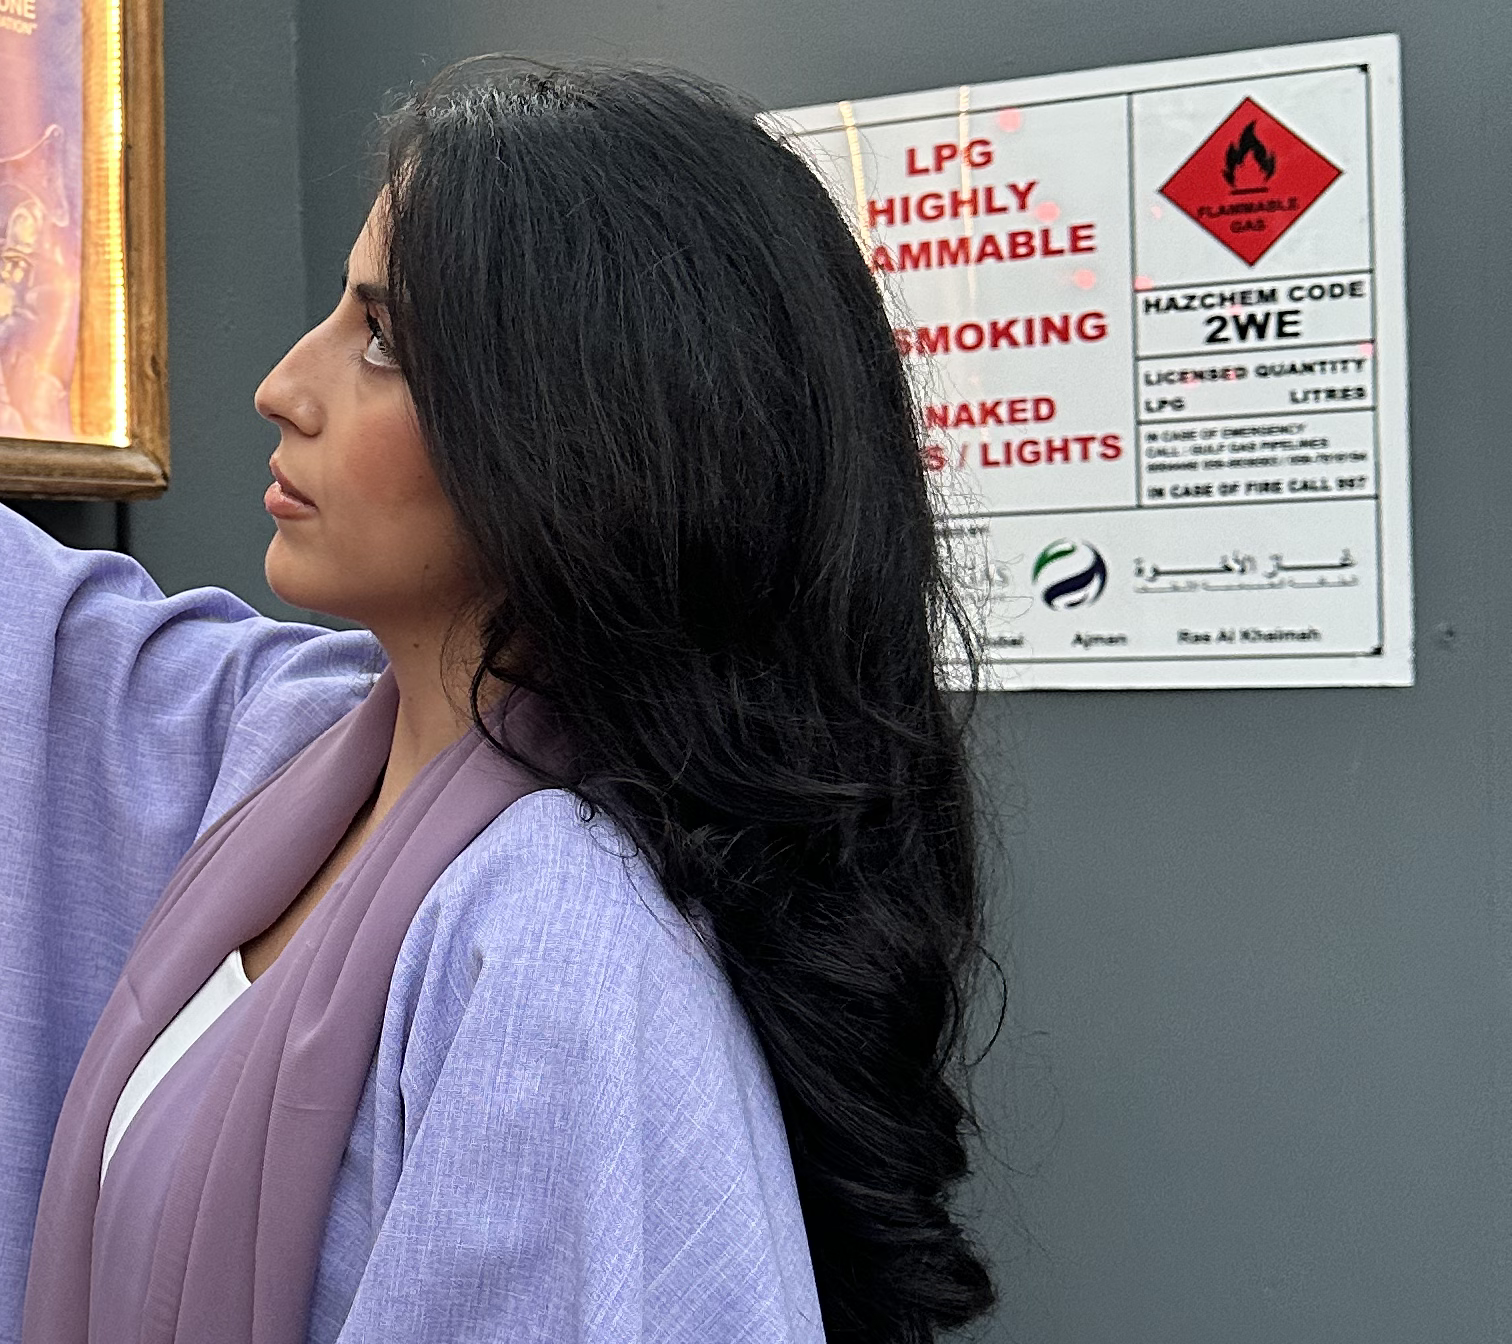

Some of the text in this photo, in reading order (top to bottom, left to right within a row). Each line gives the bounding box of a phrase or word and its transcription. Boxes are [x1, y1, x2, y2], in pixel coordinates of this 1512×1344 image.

[905, 138, 995, 178] LPG
[866, 180, 1039, 228] HIGHLY
[1196, 197, 1299, 219] FLAMMABLE
[1229, 219, 1266, 234] GAS
[871, 223, 1098, 275] AMMABLE
[1143, 280, 1366, 314] HAZCHEM CODE
[893, 311, 1109, 356] SMOKING
[1205, 309, 1302, 343] 2WE
[1144, 358, 1367, 387] LICENSED QUANTITY
[924, 396, 1057, 430] NAKED
[1144, 387, 1367, 413] LPG LITRES
[980, 434, 1124, 469] LIGHTS
[1146, 486, 1165, 499] IN
[1170, 483, 1213, 498] CASE
[1218, 481, 1241, 496] OF
[1244, 480, 1284, 496] FIRE
[987, 632, 1025, 649] ubai
